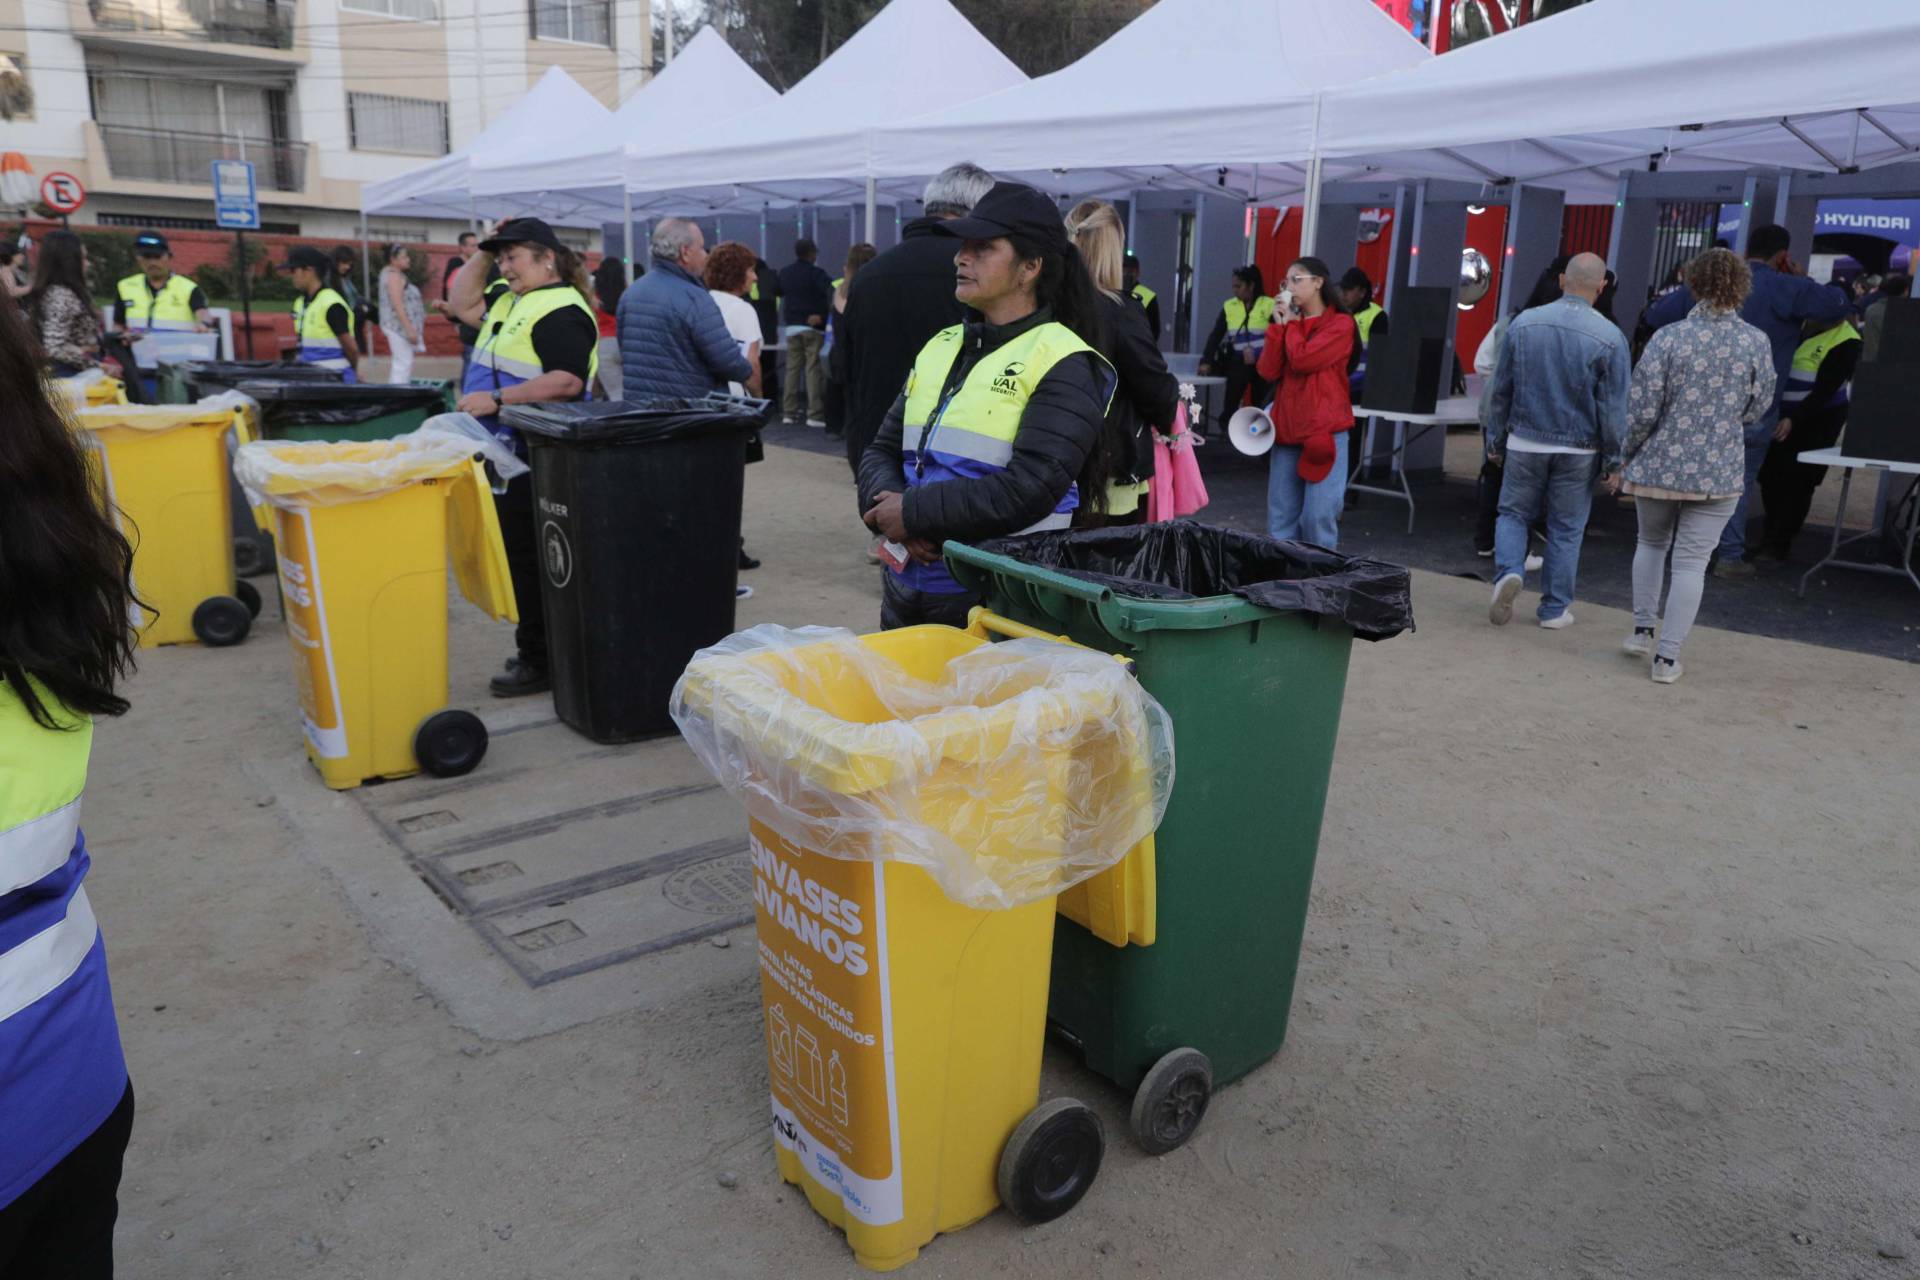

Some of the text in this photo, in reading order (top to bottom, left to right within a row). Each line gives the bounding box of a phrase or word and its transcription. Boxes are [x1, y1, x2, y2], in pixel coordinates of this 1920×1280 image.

[1823, 213, 1911, 230] HYUNDAI
[990, 386, 1016, 397] SECURITY
[993, 377, 1017, 392] VAL
[817, 1006, 877, 1047] LÍQUIDOS
